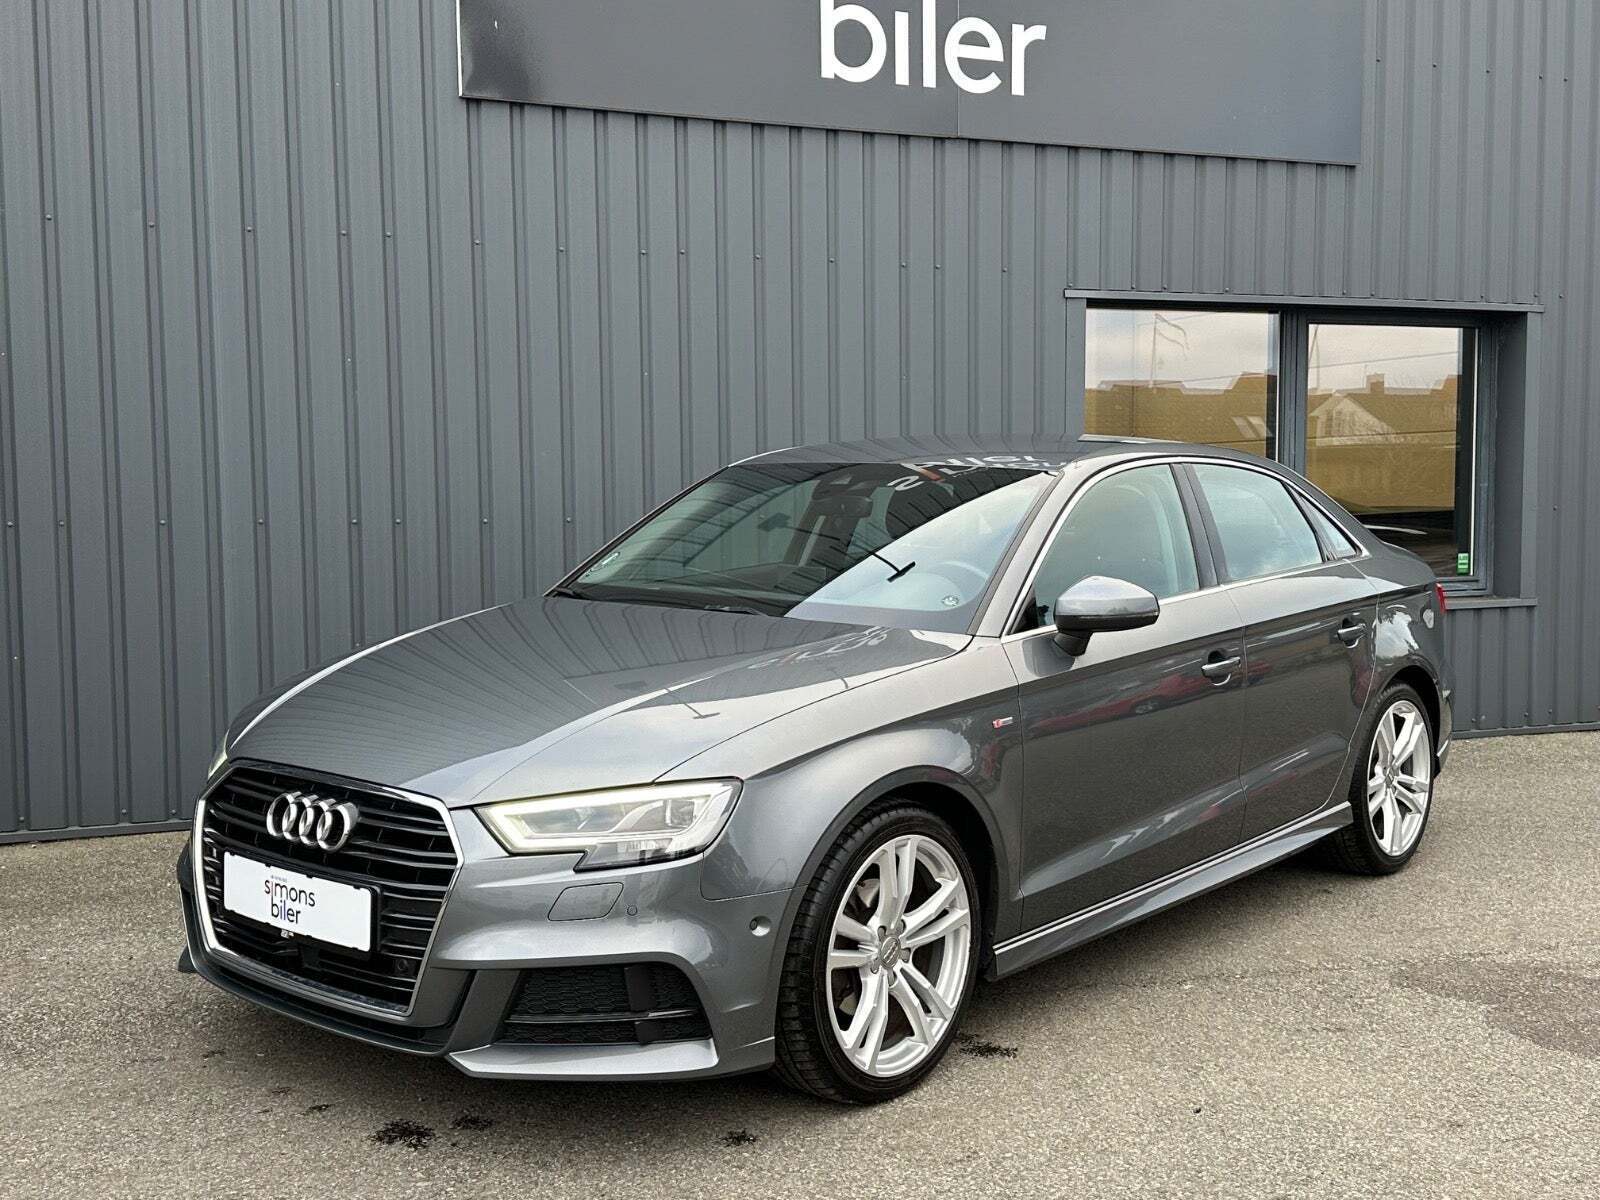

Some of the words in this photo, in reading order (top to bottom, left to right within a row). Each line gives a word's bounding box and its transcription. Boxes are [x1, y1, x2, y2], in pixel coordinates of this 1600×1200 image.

[820, 0, 1047, 96] biler
[264, 879, 316, 907] simons
[270, 898, 301, 924] biler
